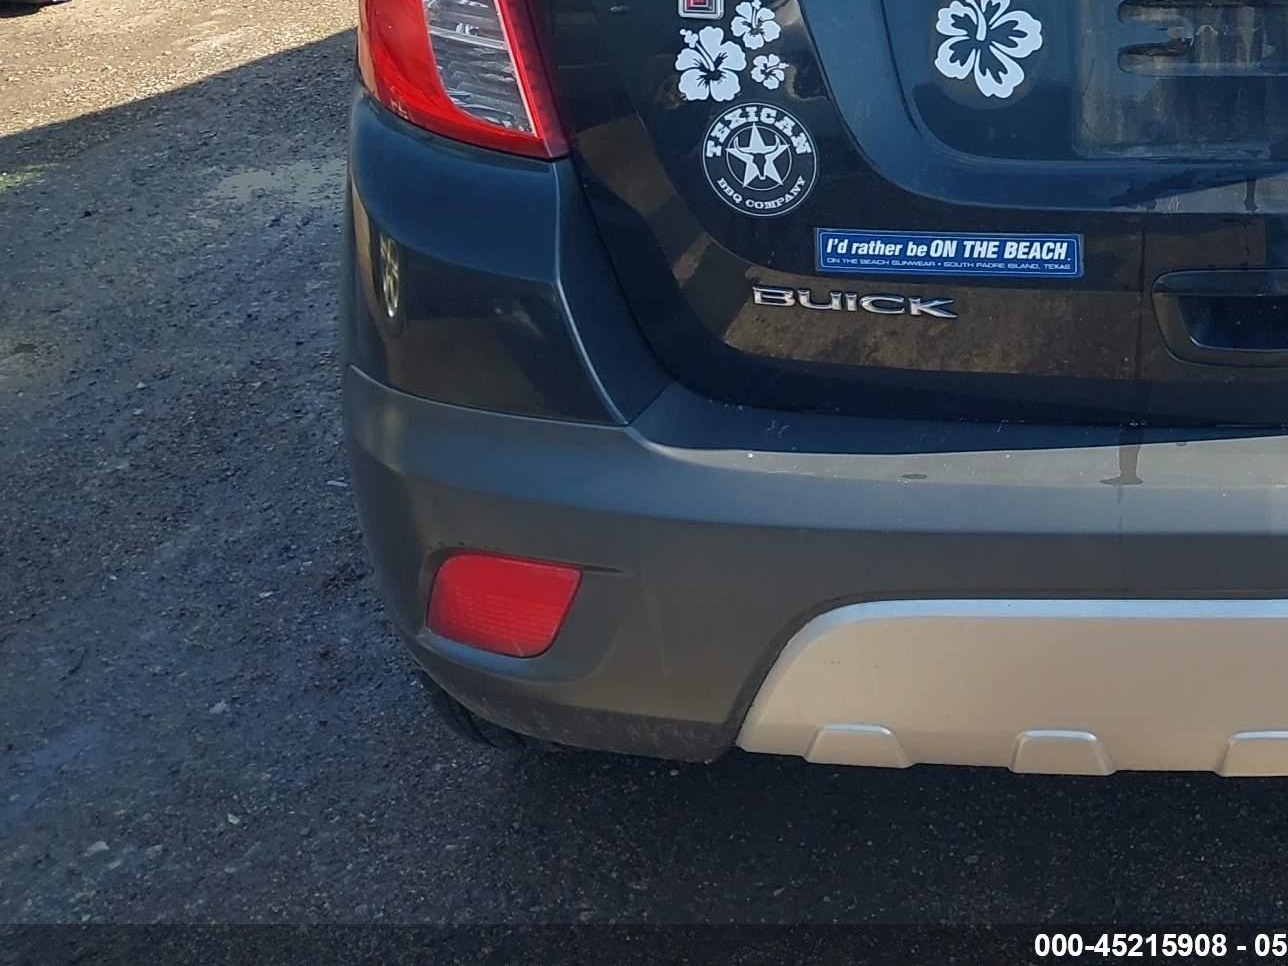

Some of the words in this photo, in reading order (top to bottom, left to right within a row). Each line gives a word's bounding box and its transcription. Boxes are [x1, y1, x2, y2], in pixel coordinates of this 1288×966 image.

[705, 106, 812, 158] TEXICAN
[717, 177, 743, 204] BBQ
[745, 175, 806, 210] COMPANY
[826, 238, 848, 254] I'd
[851, 240, 903, 256] rather
[906, 241, 928, 257] be
[929, 239, 958, 258] ON
[963, 240, 1000, 259] THE
[842, 257, 858, 265] THE
[860, 258, 889, 266] BEACH
[891, 259, 936, 267] SUNWEAR
[1043, 262, 1071, 270] TEXAS
[751, 286, 959, 319] BUICK
